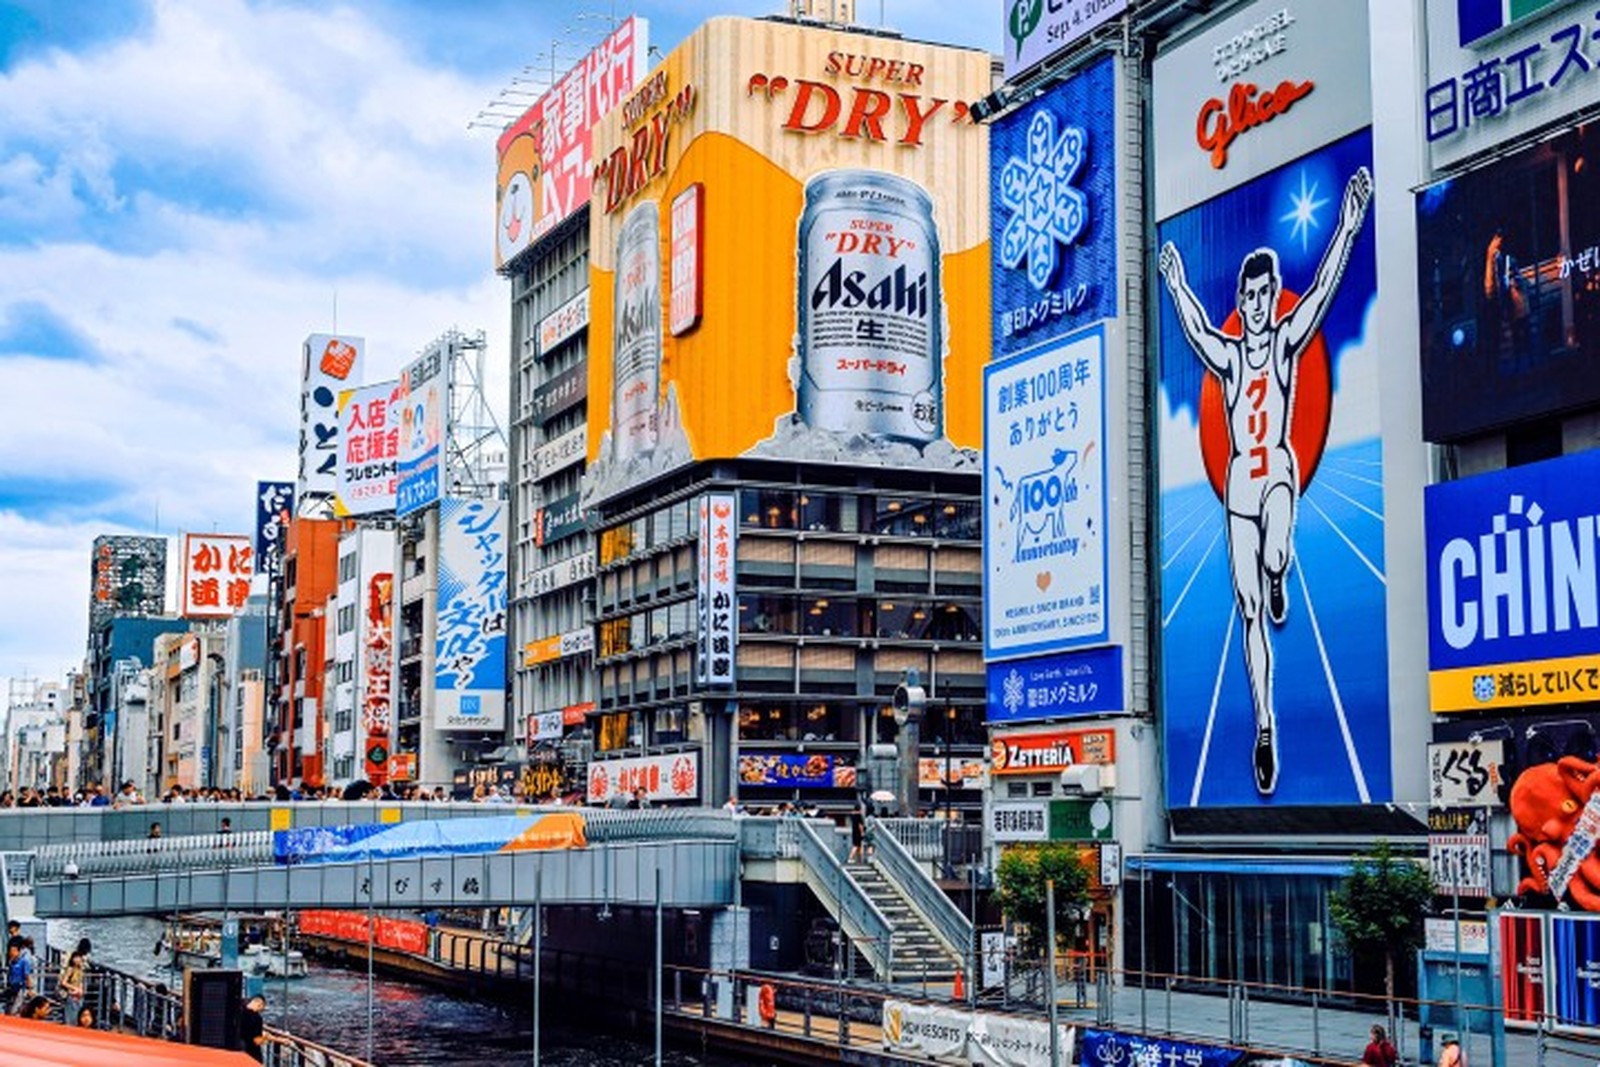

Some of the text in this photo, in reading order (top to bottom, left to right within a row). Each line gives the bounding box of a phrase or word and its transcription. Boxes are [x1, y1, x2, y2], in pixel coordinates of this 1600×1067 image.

[826, 50, 926, 87] SUPER
[1425, 10, 1600, 142] 日商エス
[622, 70, 669, 131] SUPER
[1197, 79, 1314, 169] Glico
[849, 218, 894, 234] SUPER
[811, 257, 928, 319] Asahi
[1001, 283, 1088, 337] 雪印メグミルク
[857, 318, 886, 342] 生
[837, 358, 908, 377] スーパードライ
[997, 358, 1091, 414] 創業100周年
[346, 400, 386, 433] 入店
[1008, 401, 1079, 447] ありがとう
[1245, 371, 1269, 480] グリコ
[193, 543, 252, 573] かに
[1440, 500, 1600, 649] CHIN
[712, 591, 731, 678] かに道楽
[1027, 681, 1098, 708] 雪印メグミルク
[1442, 748, 1489, 797] くくる
[361, 877, 479, 895] えびす橋
